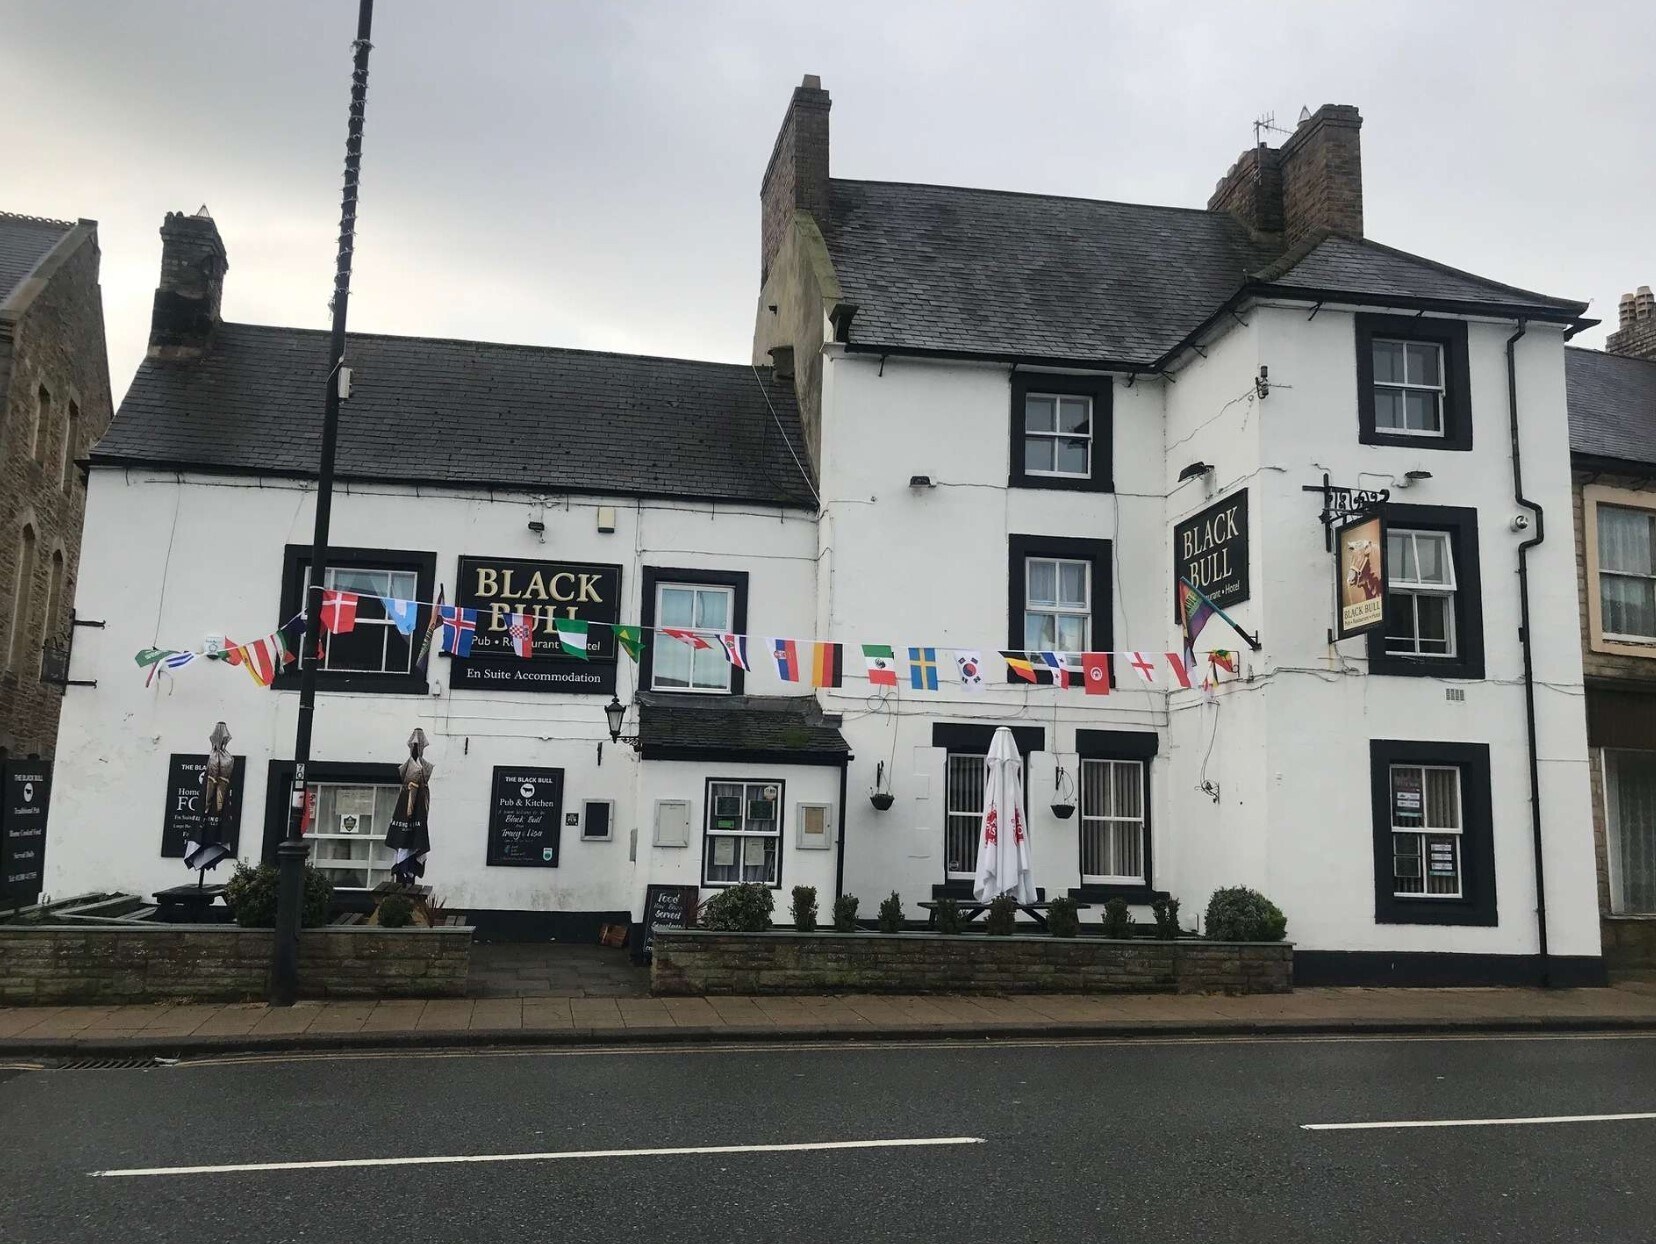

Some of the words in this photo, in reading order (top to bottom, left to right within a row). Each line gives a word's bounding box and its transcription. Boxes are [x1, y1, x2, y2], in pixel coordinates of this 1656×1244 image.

[1183, 506, 1239, 560] BLACK
[1190, 547, 1233, 590] BULL
[475, 567, 603, 602] BLACK
[1225, 580, 1240, 595] Hotel
[1344, 606, 1363, 619] BLACK
[1364, 601, 1381, 613] BULL
[472, 636, 491, 646] Pub
[502, 638, 560, 650] Reurant
[467, 668, 481, 678] En
[484, 669, 511, 680] Suite
[514, 670, 601, 683] Accommodation
[500, 798, 514, 807] Pub
[515, 798, 523, 807] &
[525, 798, 554, 808] Kitchen
[658, 892, 681, 904] Food
